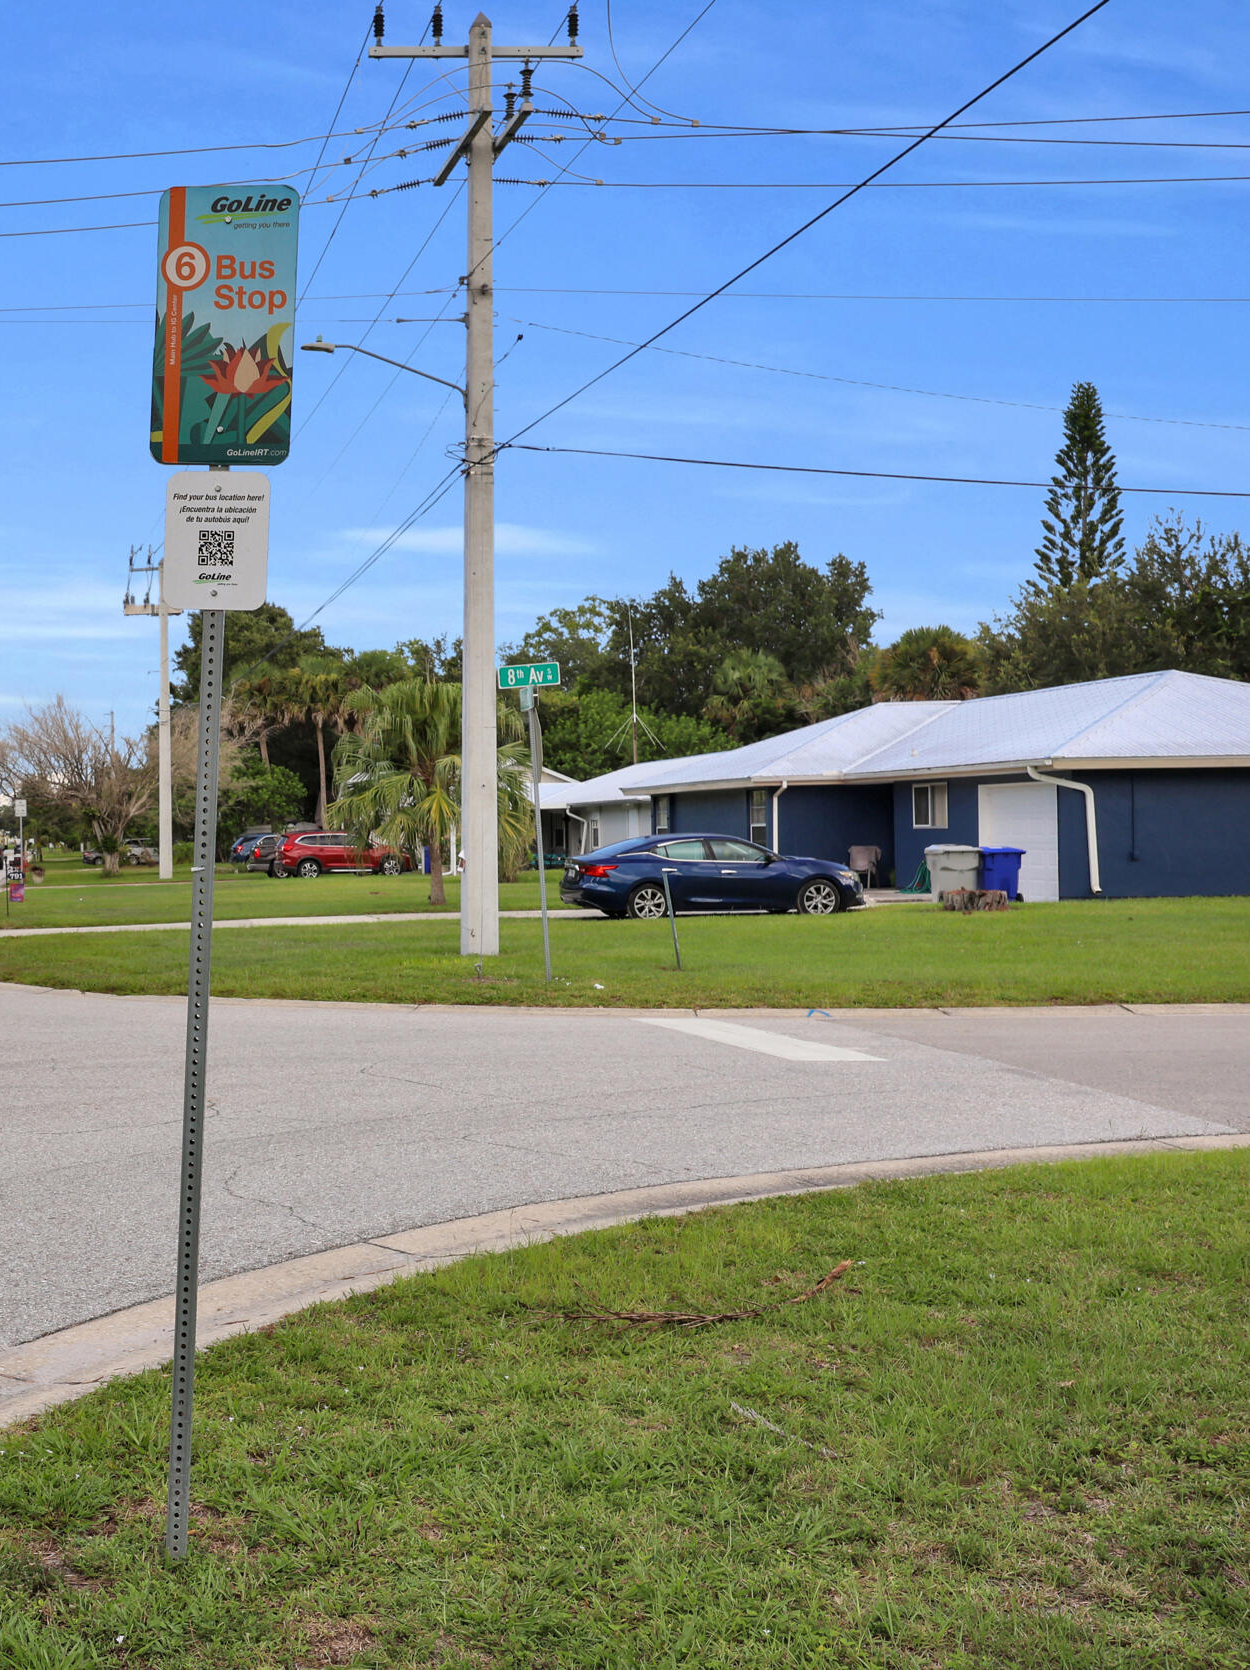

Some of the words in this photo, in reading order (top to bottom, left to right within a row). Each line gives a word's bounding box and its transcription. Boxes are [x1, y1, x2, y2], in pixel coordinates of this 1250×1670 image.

[211, 194, 292, 213] GoLine
[233, 222, 257, 230] getting
[273, 220, 290, 228] there
[175, 251, 196, 281] 6
[216, 254, 275, 280] Bus
[214, 284, 287, 315] Stop
[171, 325, 177, 333] to
[226, 448, 287, 457] GoLineIRT.com
[173, 493, 188, 501] Find
[188, 494, 204, 502] your
[205, 493, 218, 501] bus
[218, 493, 246, 501] location
[246, 494, 265, 502] here!
[179, 505, 216, 514] ¡Encuentra
[224, 505, 257, 514] ubicación
[185, 515, 195, 523] de
[204, 515, 231, 523] autobús
[198, 572, 232, 581] GoLine
[508, 668, 524, 685] 8th
[528, 667, 544, 684] Av
